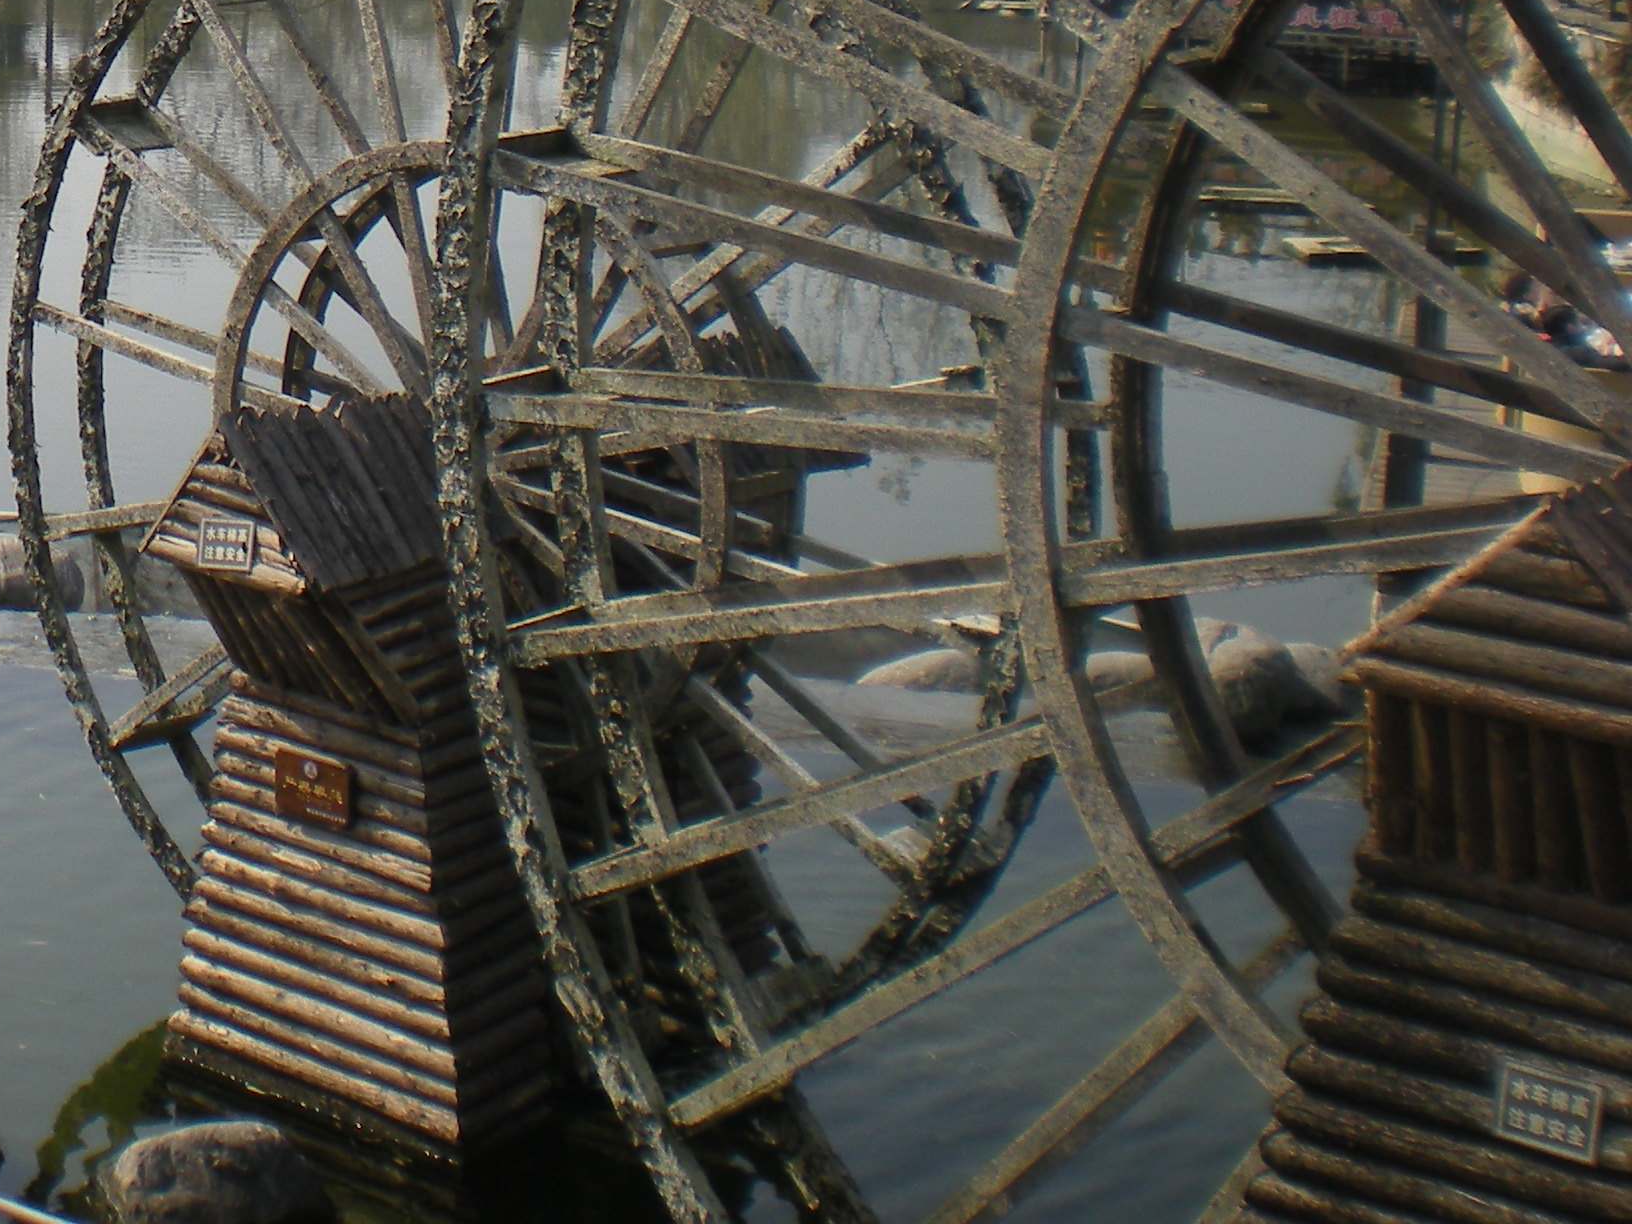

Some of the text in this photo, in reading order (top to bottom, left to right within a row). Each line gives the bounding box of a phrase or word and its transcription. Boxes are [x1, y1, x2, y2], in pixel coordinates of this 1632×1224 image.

[204, 545, 245, 562] 注意安全
[1508, 1107, 1586, 1148] 注意安全
